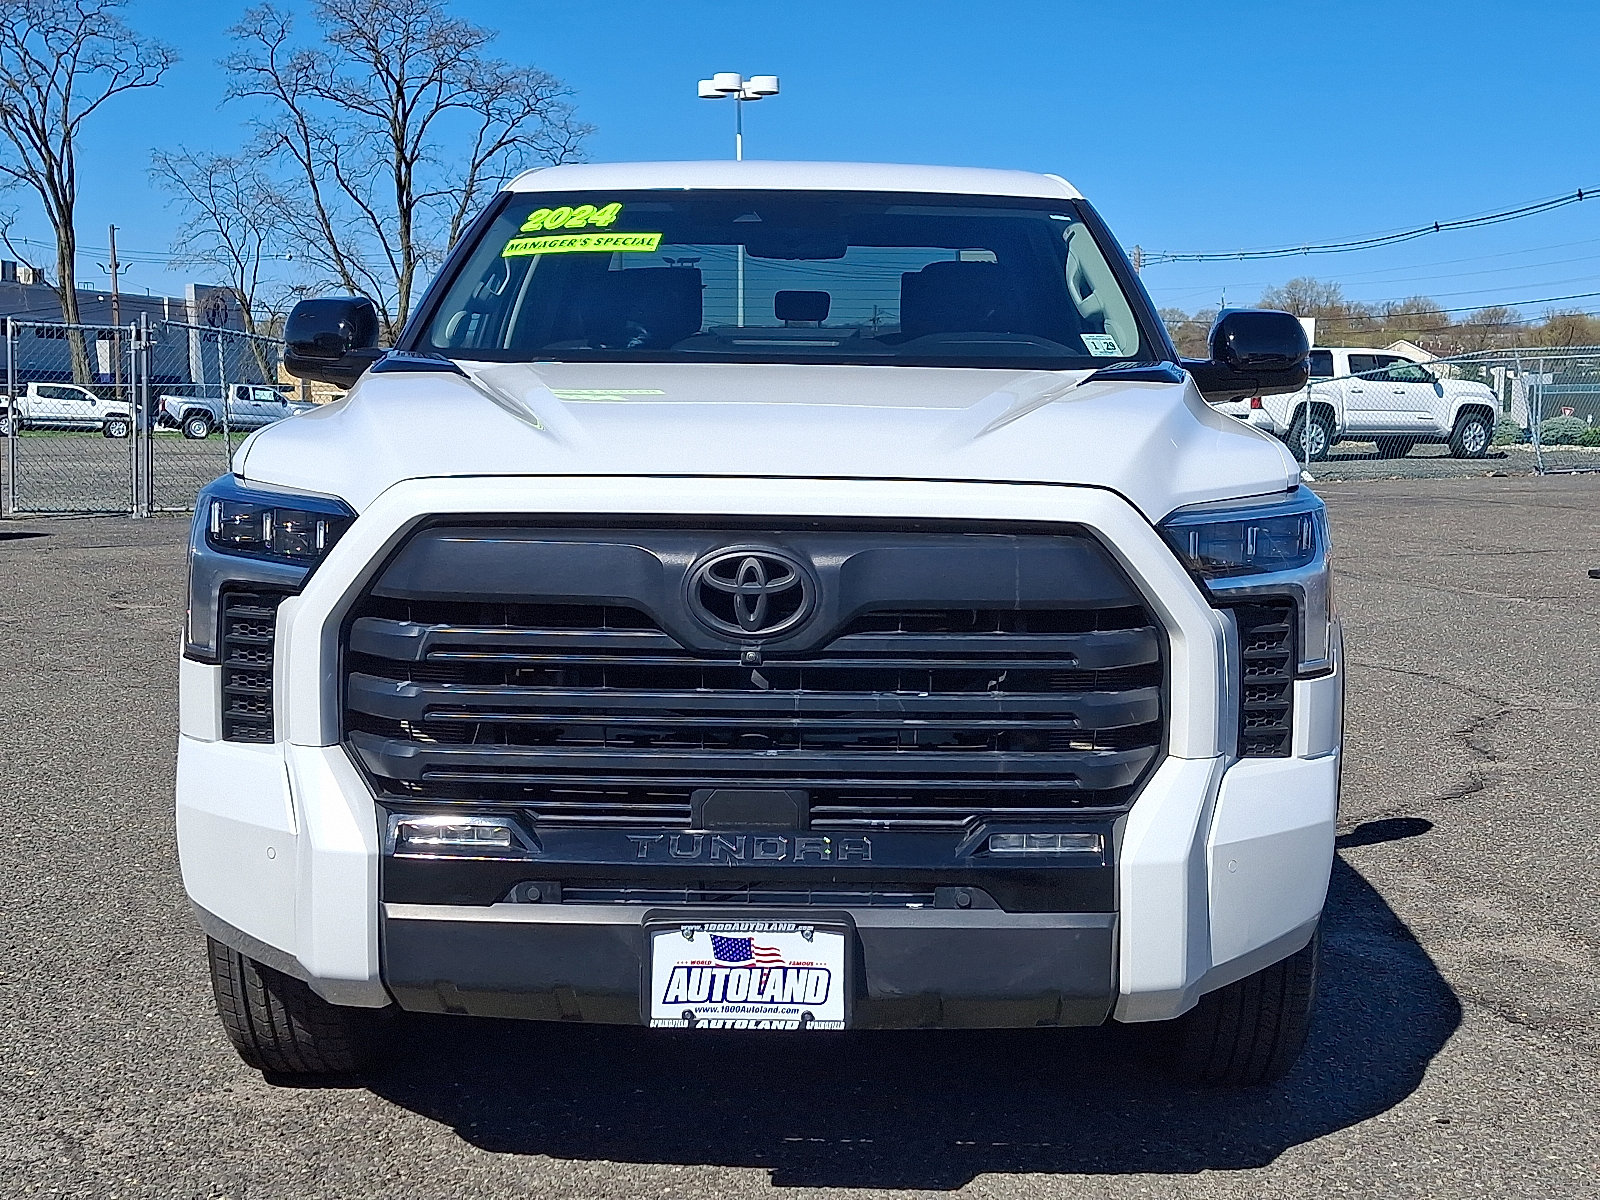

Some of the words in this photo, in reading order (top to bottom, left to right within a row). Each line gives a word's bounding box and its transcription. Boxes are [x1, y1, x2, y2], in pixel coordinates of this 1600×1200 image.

[520, 202, 623, 232] 2024
[507, 237, 590, 251] MANAGER'S
[593, 236, 656, 246] SPECIAL
[1091, 341, 1100, 350] 1
[1103, 341, 1117, 351] 29
[625, 834, 873, 862] TUNDRA
[662, 966, 832, 1005] AUTOLAND
[696, 1019, 800, 1030] AUTOLAND
